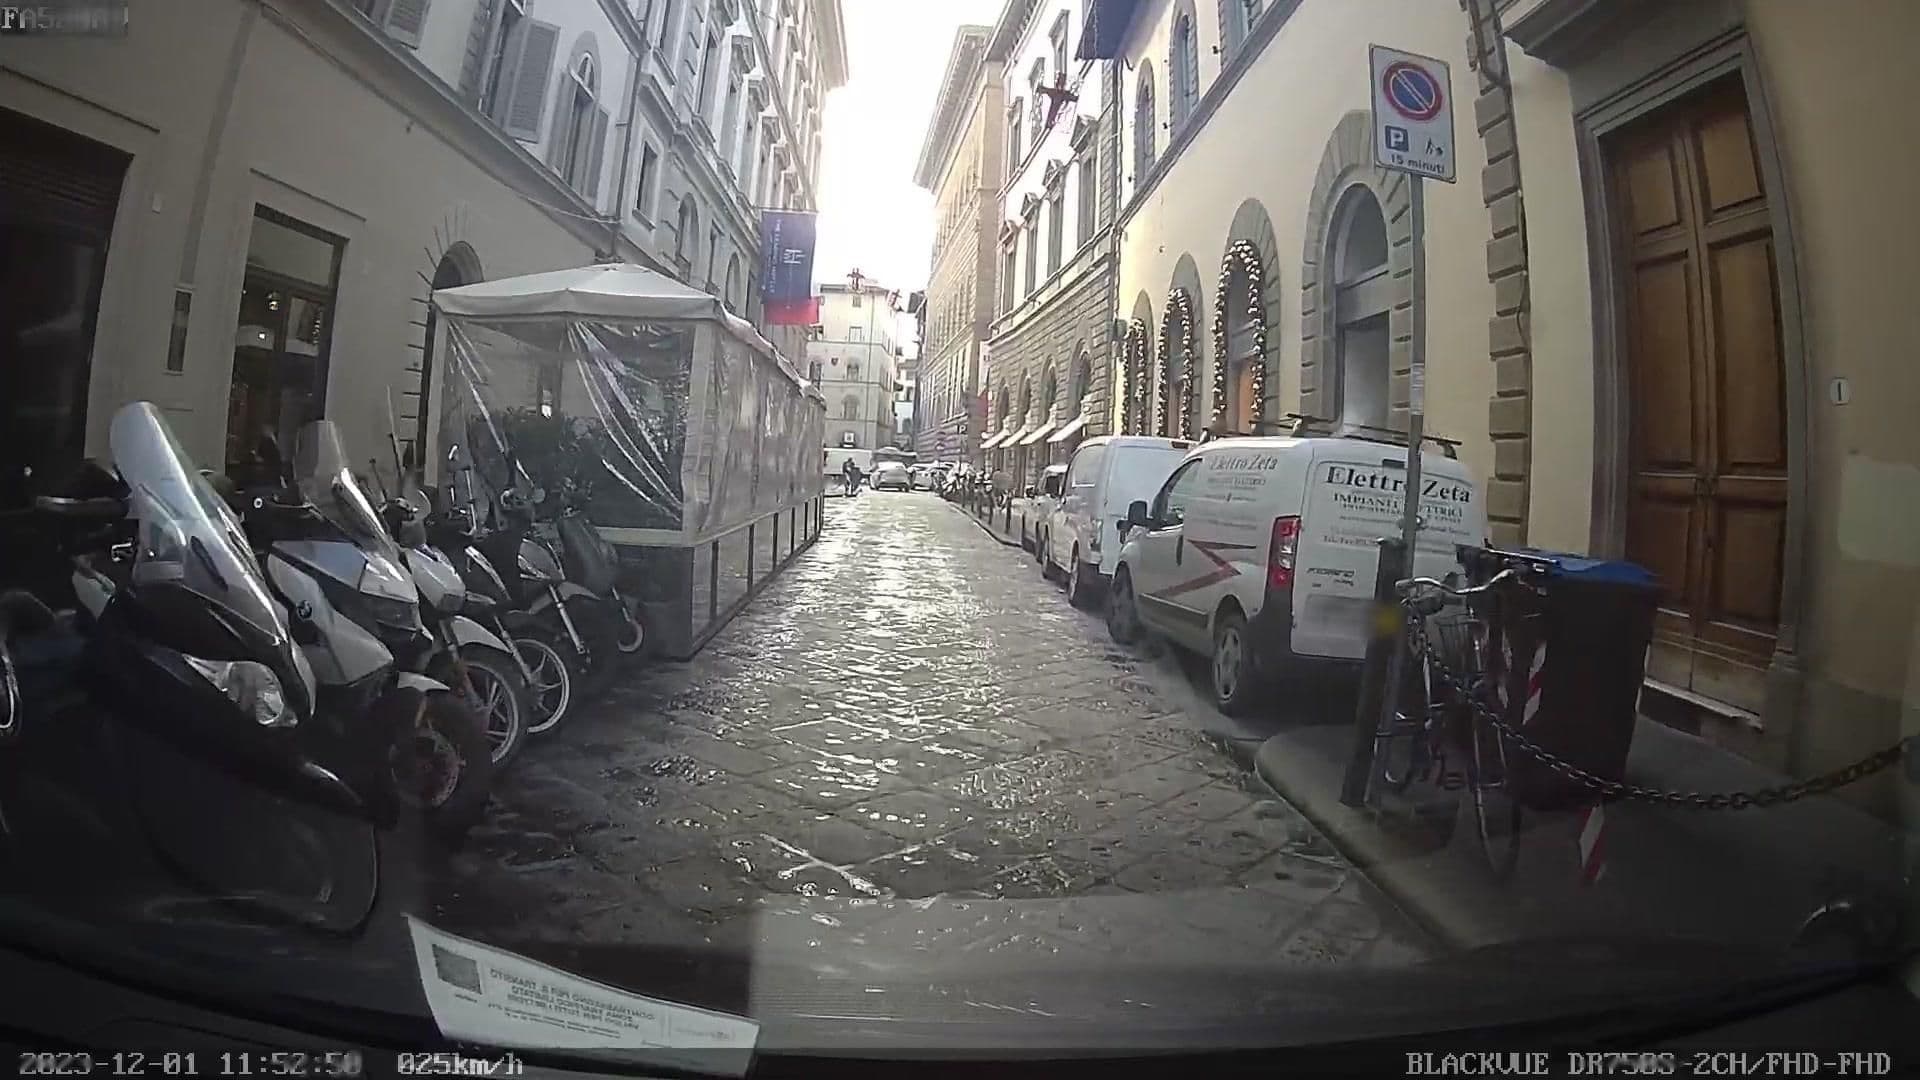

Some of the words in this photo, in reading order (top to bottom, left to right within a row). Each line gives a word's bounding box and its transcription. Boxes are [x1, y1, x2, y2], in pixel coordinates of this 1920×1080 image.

[1390, 127, 1404, 148] P
[1391, 154, 1403, 165] 15
[1408, 159, 1445, 174] minuti
[1248, 454, 1279, 471] Zeta
[1421, 479, 1471, 503] Zeta
